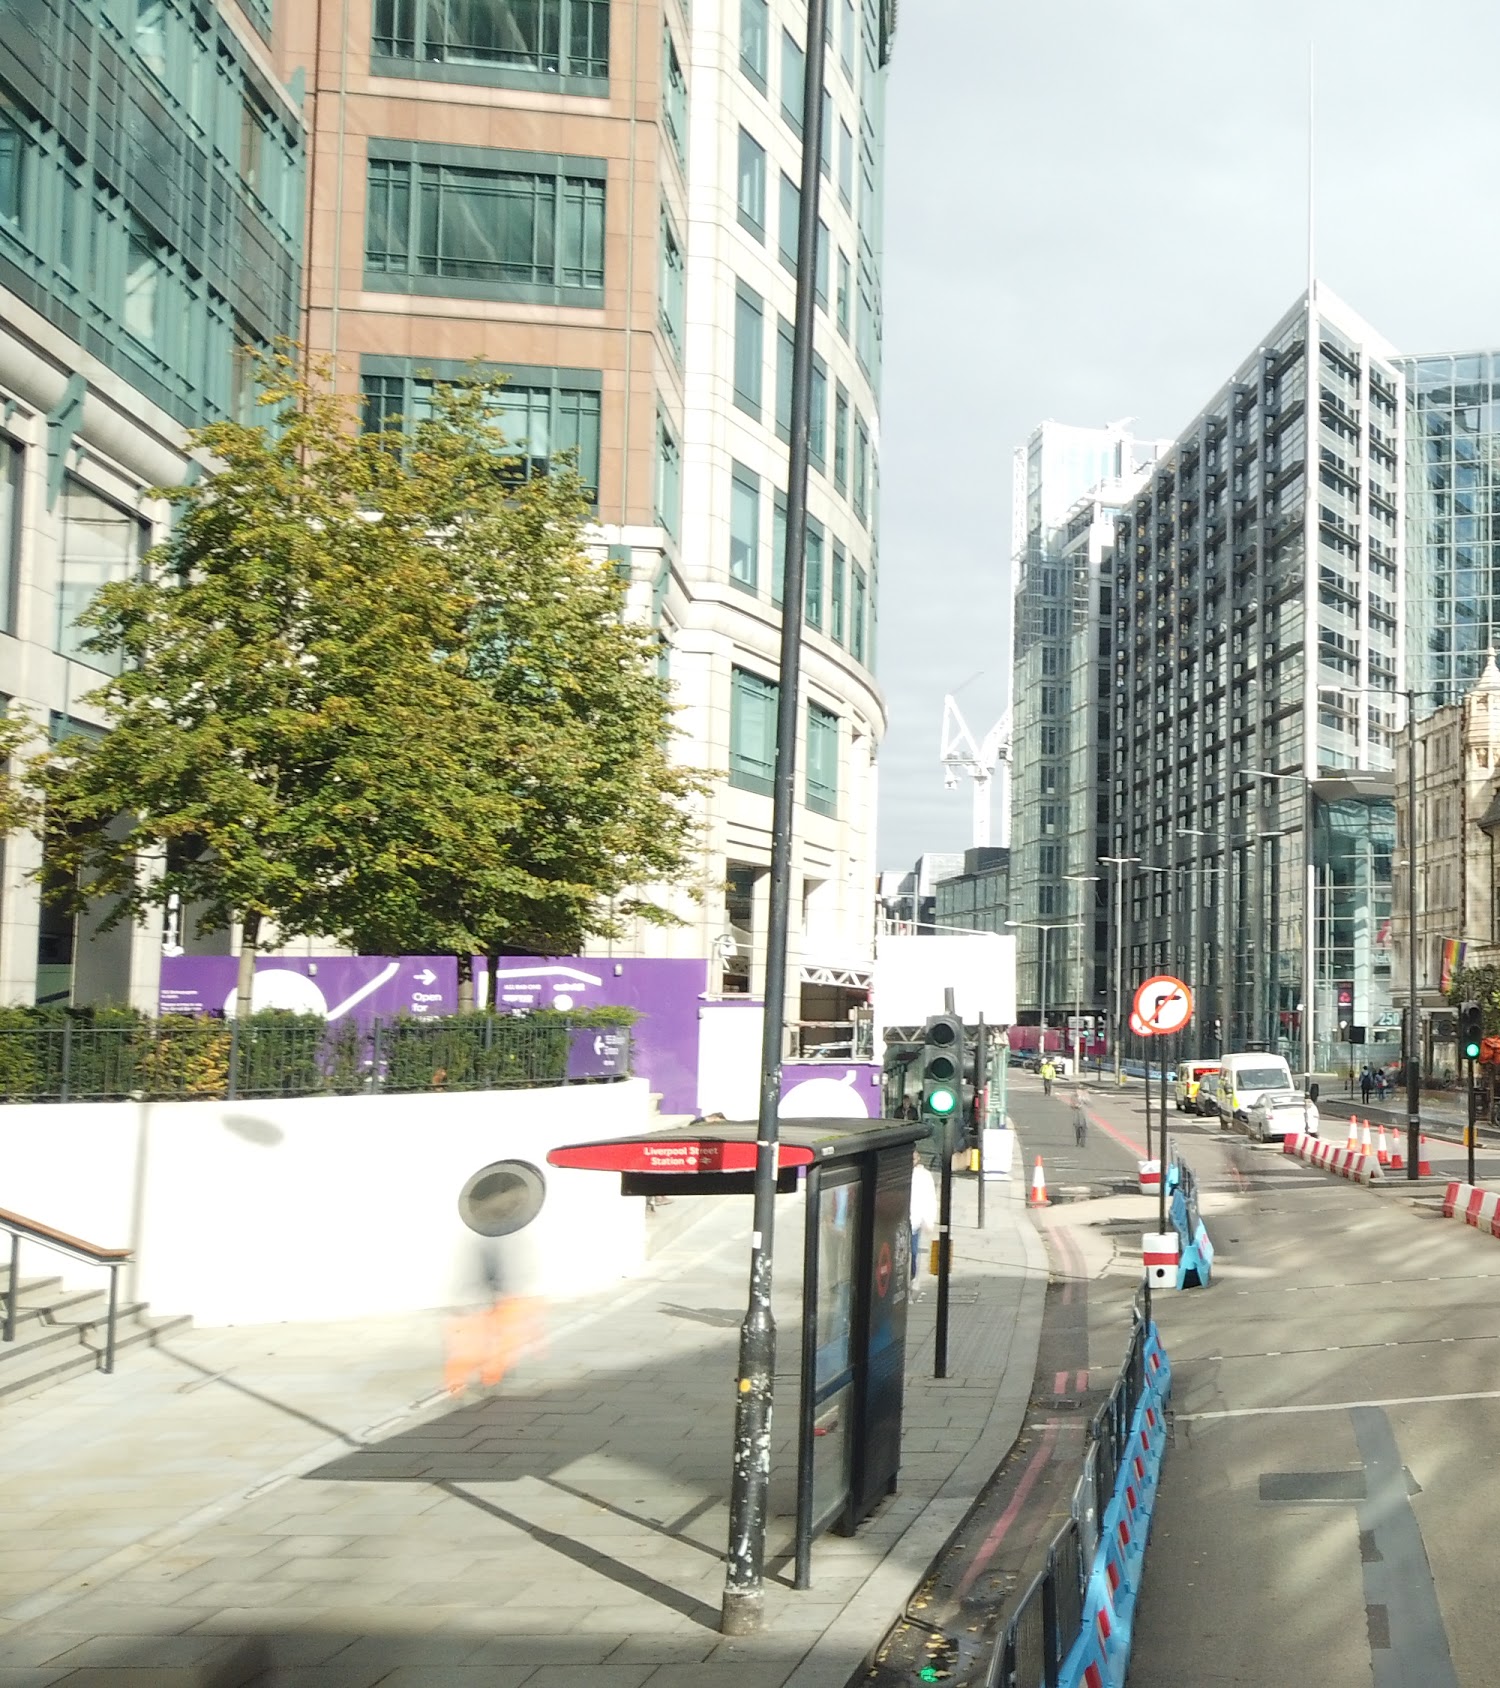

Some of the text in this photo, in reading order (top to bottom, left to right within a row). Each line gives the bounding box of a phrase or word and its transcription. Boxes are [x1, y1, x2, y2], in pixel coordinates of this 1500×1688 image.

[412, 993, 442, 1003] Open
[412, 1003, 428, 1012] for
[1379, 1012, 1400, 1025] 250
[644, 1147, 718, 1156] Liverpool Street
[651, 1156, 684, 1165] Station
